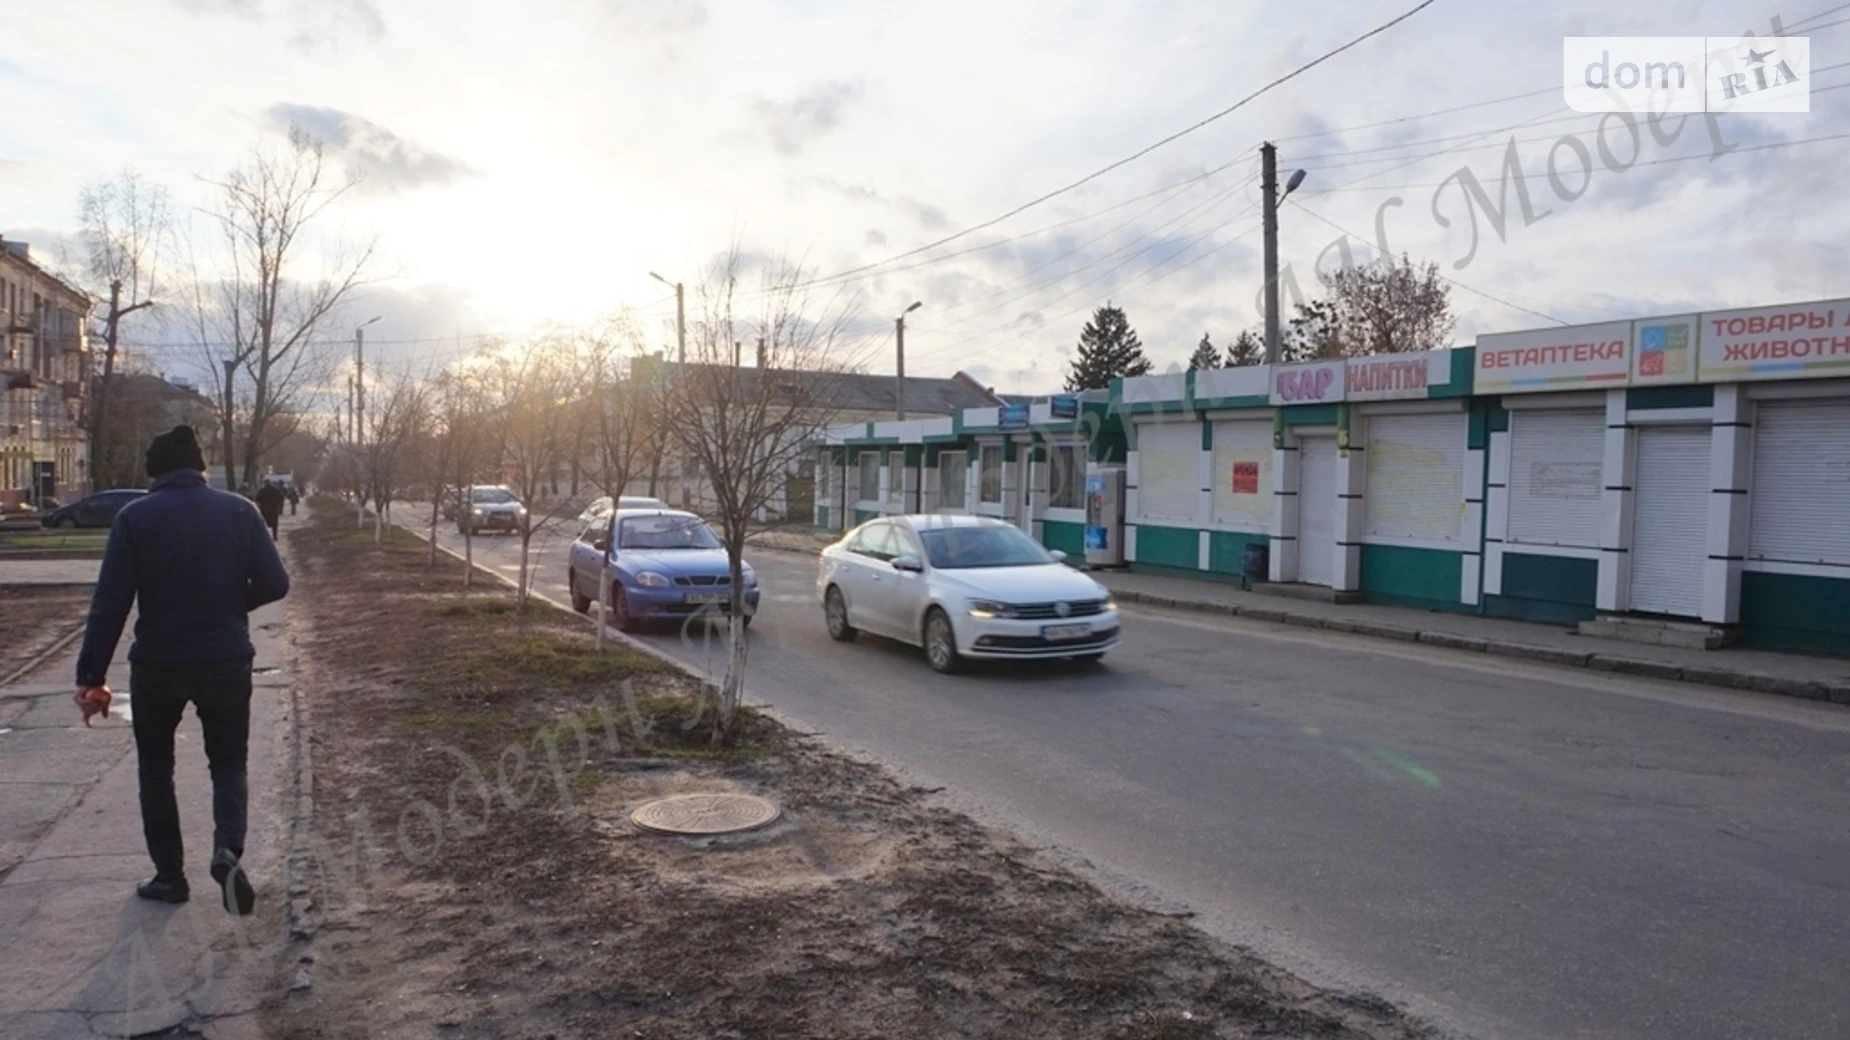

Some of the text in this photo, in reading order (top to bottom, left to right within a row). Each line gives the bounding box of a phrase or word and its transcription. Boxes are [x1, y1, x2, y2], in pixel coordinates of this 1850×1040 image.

[1711, 310, 1834, 337] ТОВАРЫ
[1481, 340, 1625, 370] ВЕТАПТЕКА
[1723, 334, 1850, 362] ЖИВОТН
[1278, 368, 1334, 401] БАР
[1347, 359, 1428, 393] НАПИТКИ
